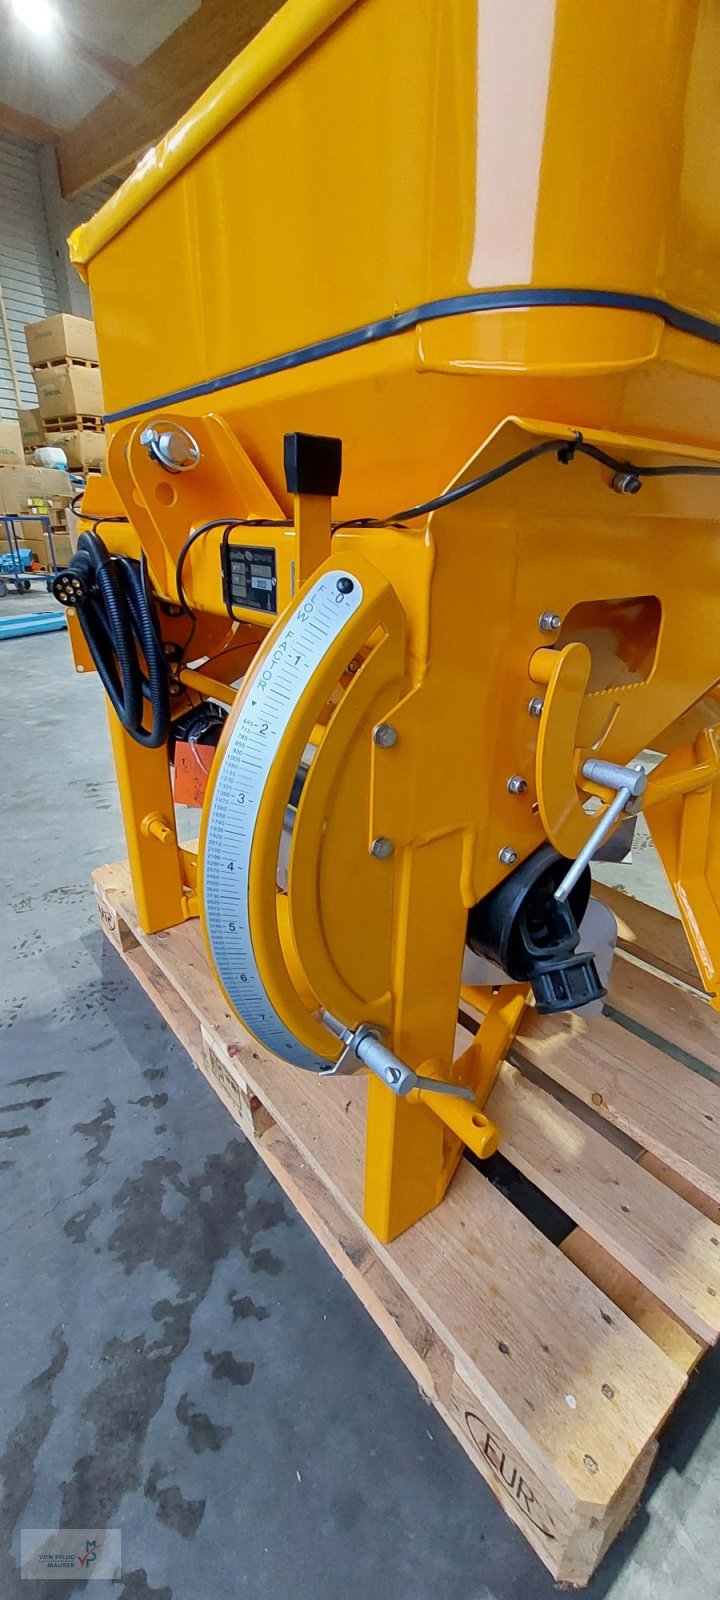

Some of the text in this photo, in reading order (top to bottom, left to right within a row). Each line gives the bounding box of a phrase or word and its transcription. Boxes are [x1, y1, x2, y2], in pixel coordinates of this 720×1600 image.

[256, 585, 327, 693] FLOW FACTOR
[294, 655, 301, 666] 1
[259, 723, 269, 736] 2
[237, 793, 246, 804] 3
[226, 862, 234, 871] 4
[228, 922, 236, 932] 5
[240, 974, 248, 982] 6
[484, 1431, 535, 1514] EUR
